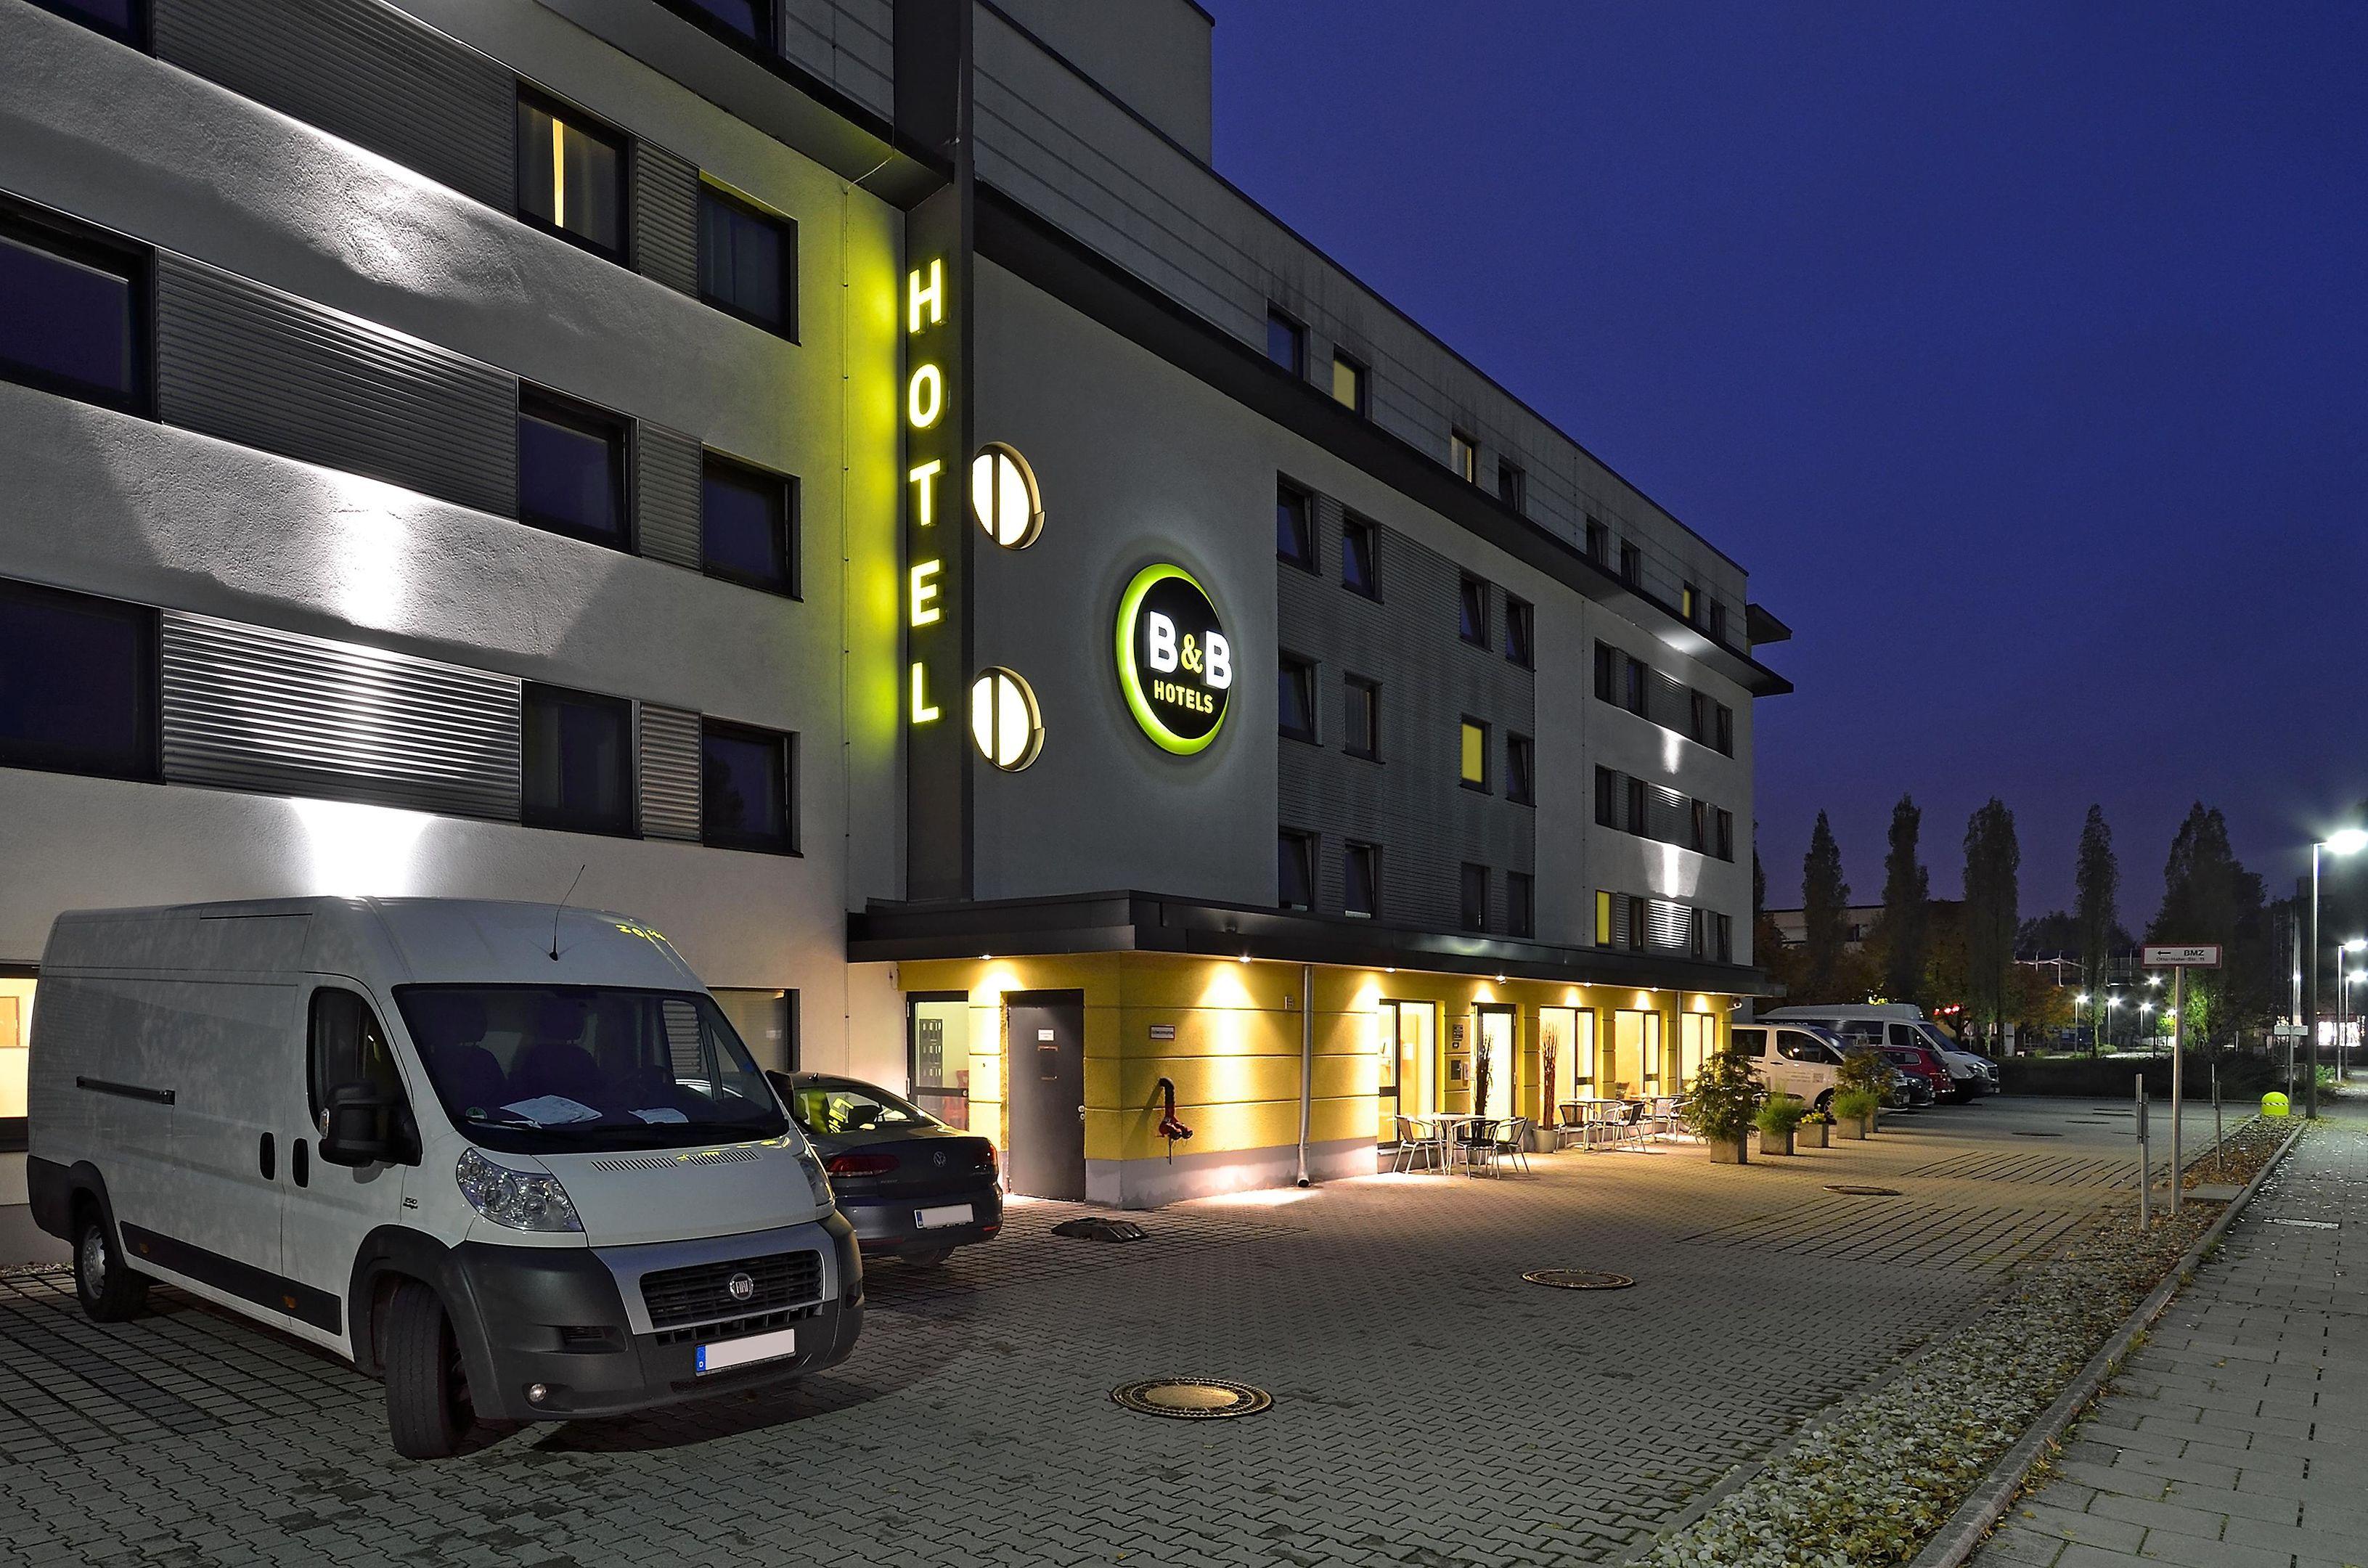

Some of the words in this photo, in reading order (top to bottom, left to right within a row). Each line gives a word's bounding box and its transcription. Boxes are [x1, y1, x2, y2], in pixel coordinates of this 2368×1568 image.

[909, 258, 942, 724] HOTEL
[1149, 611, 1233, 690] B&B
[1154, 679, 1213, 714] HOTELS
